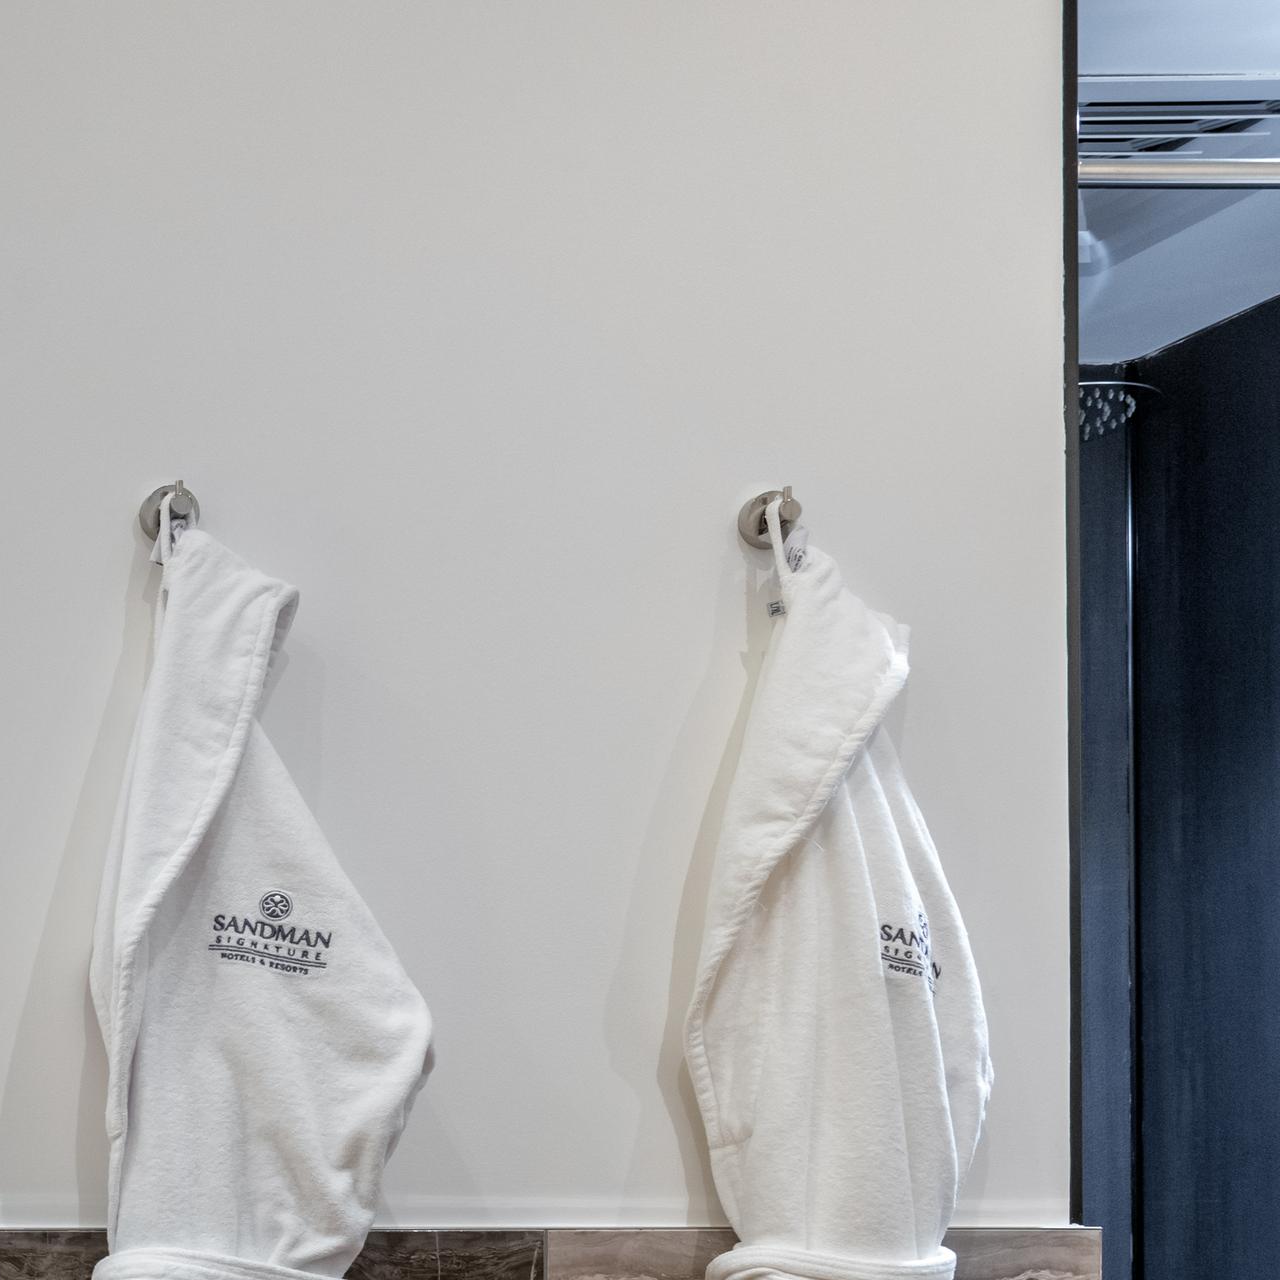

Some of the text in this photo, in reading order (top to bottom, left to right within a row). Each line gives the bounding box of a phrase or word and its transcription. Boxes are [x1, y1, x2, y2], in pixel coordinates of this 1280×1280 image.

[213, 914, 332, 949] SANDMAN
[215, 935, 322, 961] SIGNATURE
[220, 952, 256, 964] HOTELS
[269, 961, 309, 975] RESORTS
